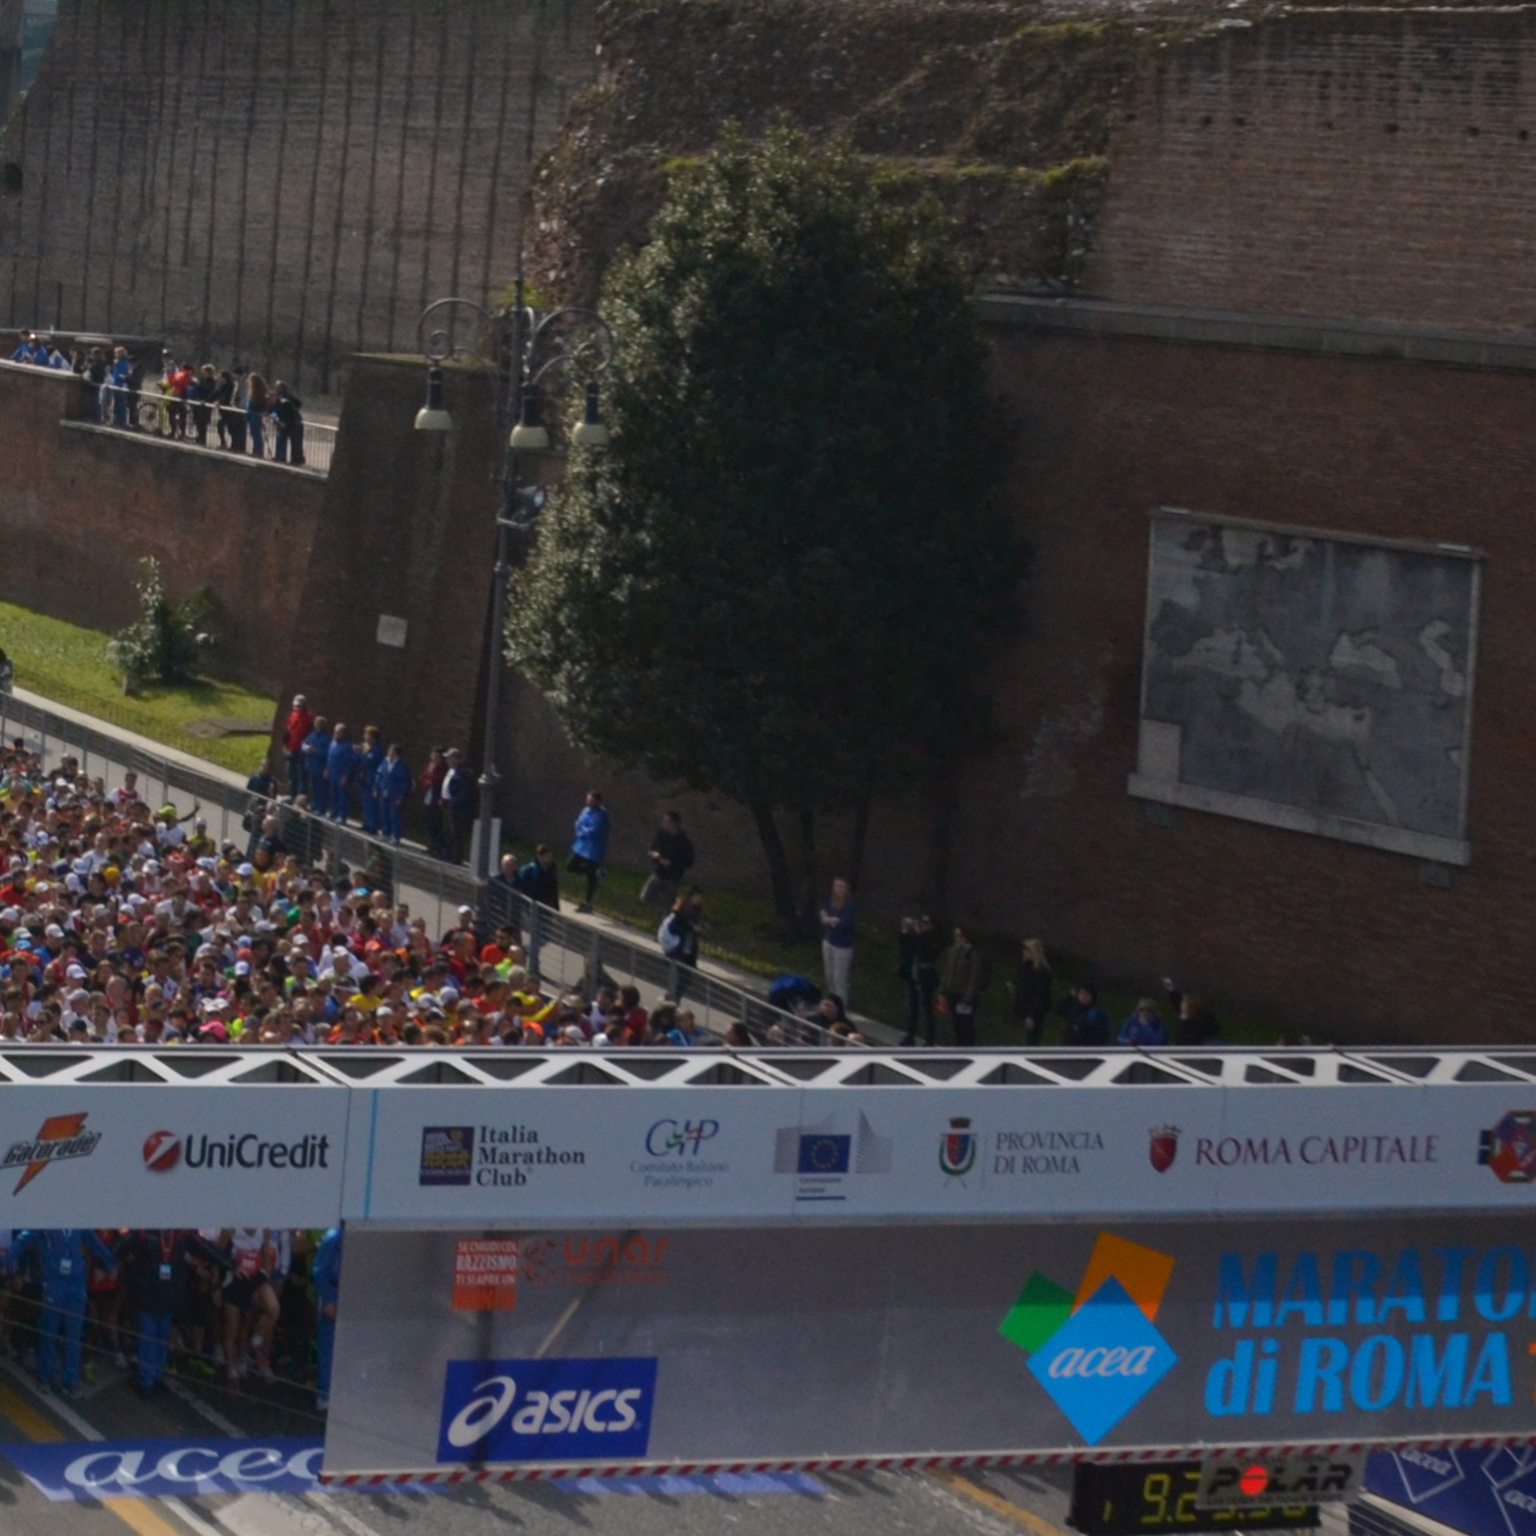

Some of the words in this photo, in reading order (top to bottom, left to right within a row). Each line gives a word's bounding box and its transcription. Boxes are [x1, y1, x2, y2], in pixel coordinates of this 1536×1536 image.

[478, 1126, 539, 1144] Italia
[995, 1131, 1104, 1150] PROVINCIA
[185, 1134, 328, 1168] UniCredit
[477, 1146, 586, 1165] Marathon
[1195, 1137, 1293, 1166] ROMA
[1299, 1134, 1440, 1164] CAPITALE
[476, 1167, 527, 1186] Club
[993, 1156, 1017, 1175] DI
[1021, 1155, 1081, 1174] ROMA
[563, 1236, 669, 1264] unar
[1213, 1244, 1536, 1328] MARATO
[1048, 1345, 1156, 1379] acea
[1204, 1337, 1279, 1417] di
[1294, 1332, 1513, 1413] ROMA
